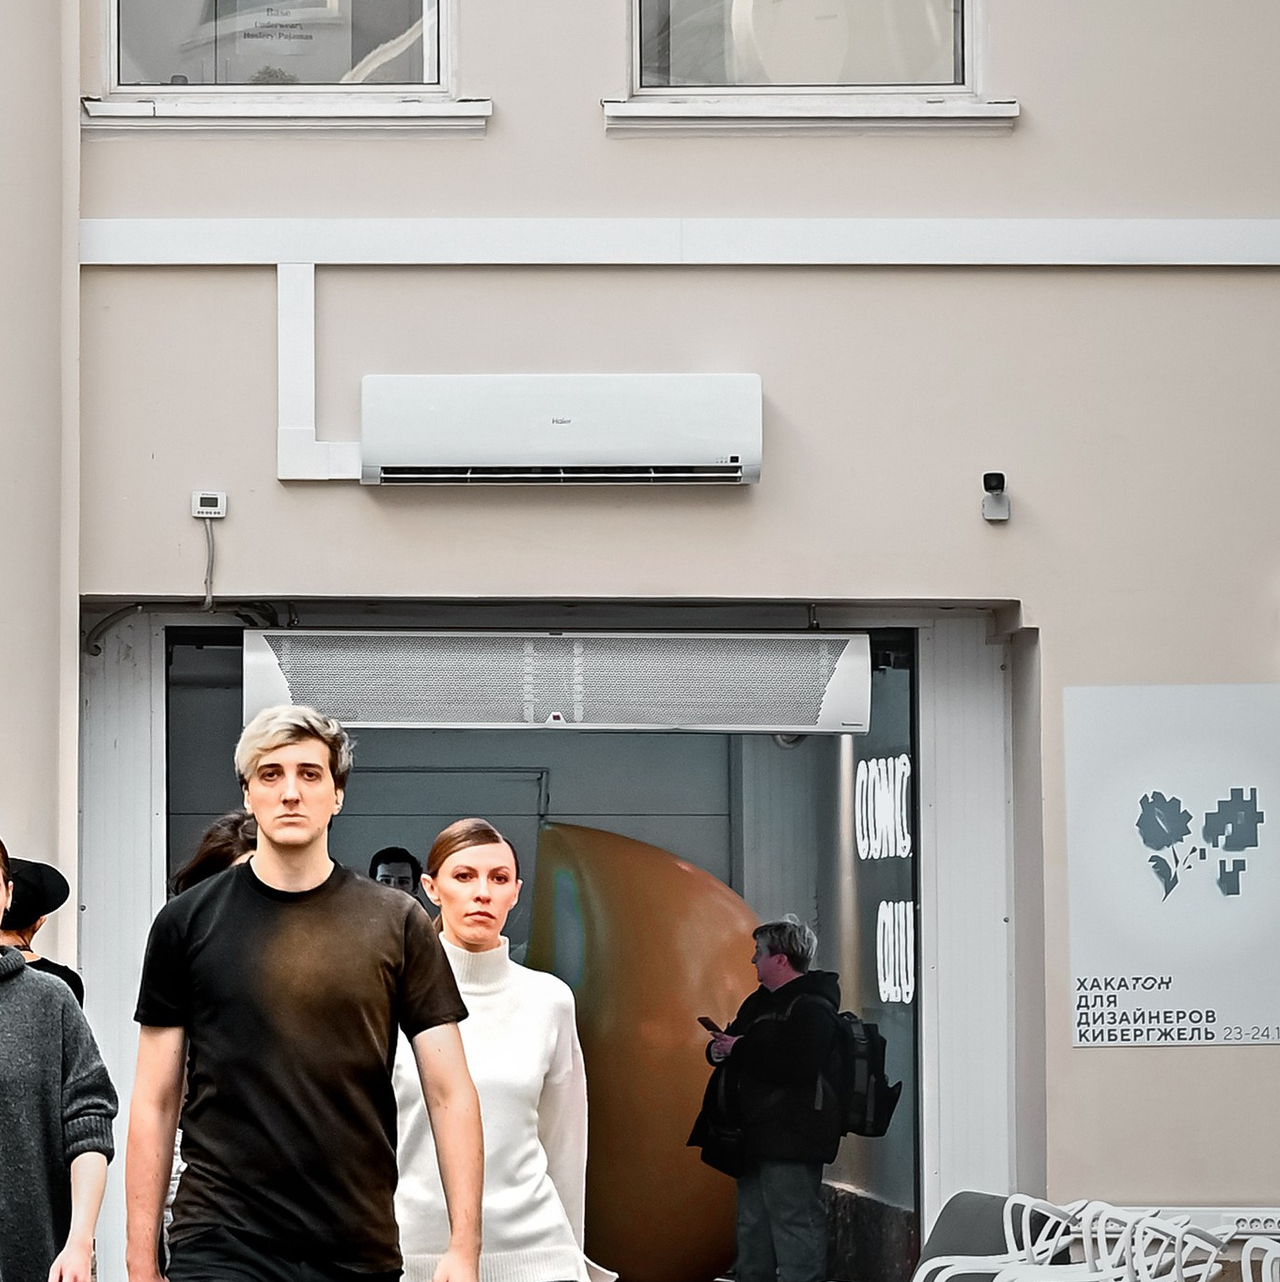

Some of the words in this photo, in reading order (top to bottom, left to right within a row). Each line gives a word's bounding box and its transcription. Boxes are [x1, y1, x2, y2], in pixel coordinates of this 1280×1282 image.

[1076, 976, 1173, 991] ХАКАТОН
[1076, 994, 1119, 1010] ДЛЯ
[1076, 1008, 1217, 1027] ДИЗАЙНЕРОВ
[1078, 1027, 1216, 1042] КИБЕРГЖЕЛЬ
[1222, 1025, 1280, 1041] 23-24.1
